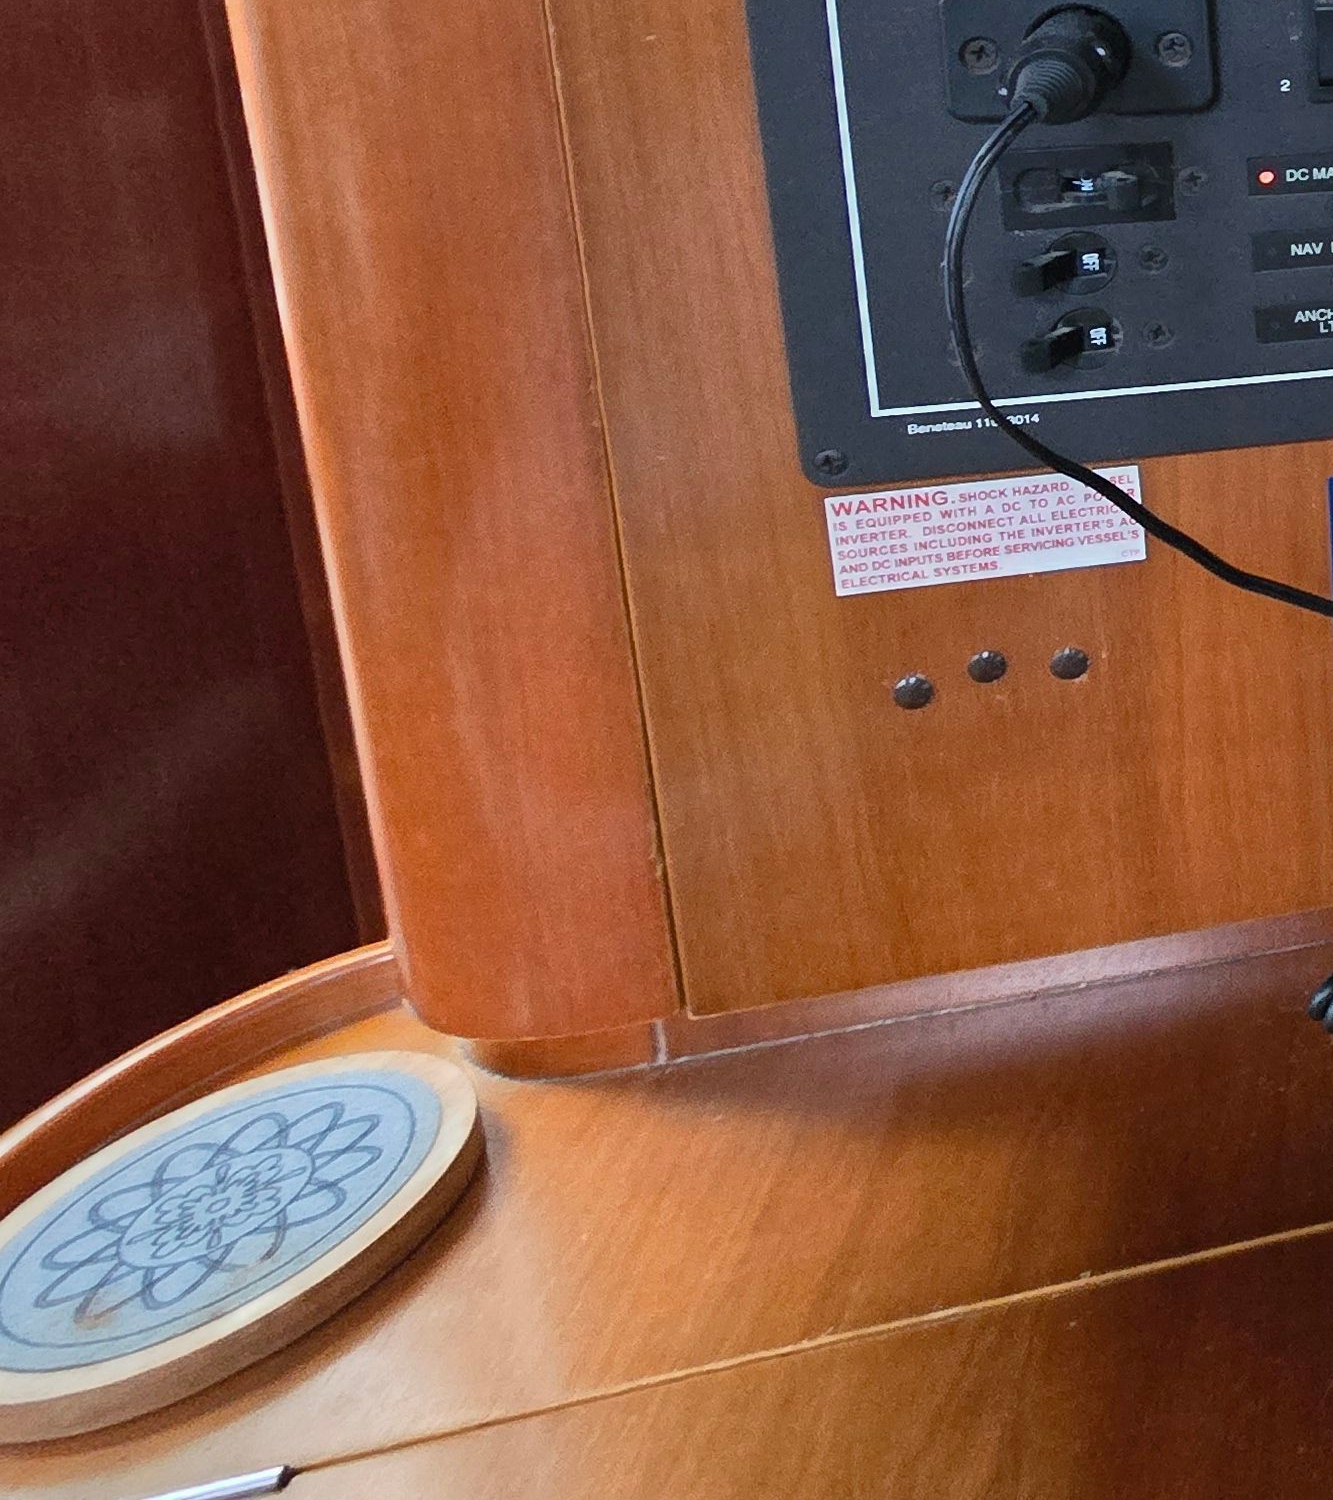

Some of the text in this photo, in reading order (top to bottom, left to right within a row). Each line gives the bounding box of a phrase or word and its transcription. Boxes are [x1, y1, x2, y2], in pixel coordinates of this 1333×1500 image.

[1280, 78, 1291, 92] 2
[1285, 167, 1309, 182] DC
[1081, 251, 1100, 272] OFF
[1290, 241, 1323, 256] NAV
[1089, 327, 1107, 346] OFF
[831, 491, 956, 517] WARNING.
[958, 488, 1008, 503] SHOCK
[1012, 482, 1073, 497] HAZARD.
[833, 519, 848, 532] IS
[856, 512, 933, 529] EQUIPPED
[939, 506, 978, 519] WITH
[984, 504, 995, 515] A
[1002, 501, 1022, 514] DC
[1030, 498, 1049, 511] TO
[1056, 495, 1076, 506] AC
[836, 529, 912, 546] INVERTER.
[922, 517, 1014, 537] DISCONNECT
[1019, 512, 1047, 524] ALL
[838, 542, 908, 561] SOURCES
[914, 533, 993, 550] INCLUDING
[999, 529, 1026, 542] THE
[1031, 518, 1115, 538] INVERTER'S
[839, 529, 1140, 575] AND DC INPUTS BEFORE SERVICING VESSEL'S
[841, 561, 1002, 590] ELECTRICAL SYSTEMS.
